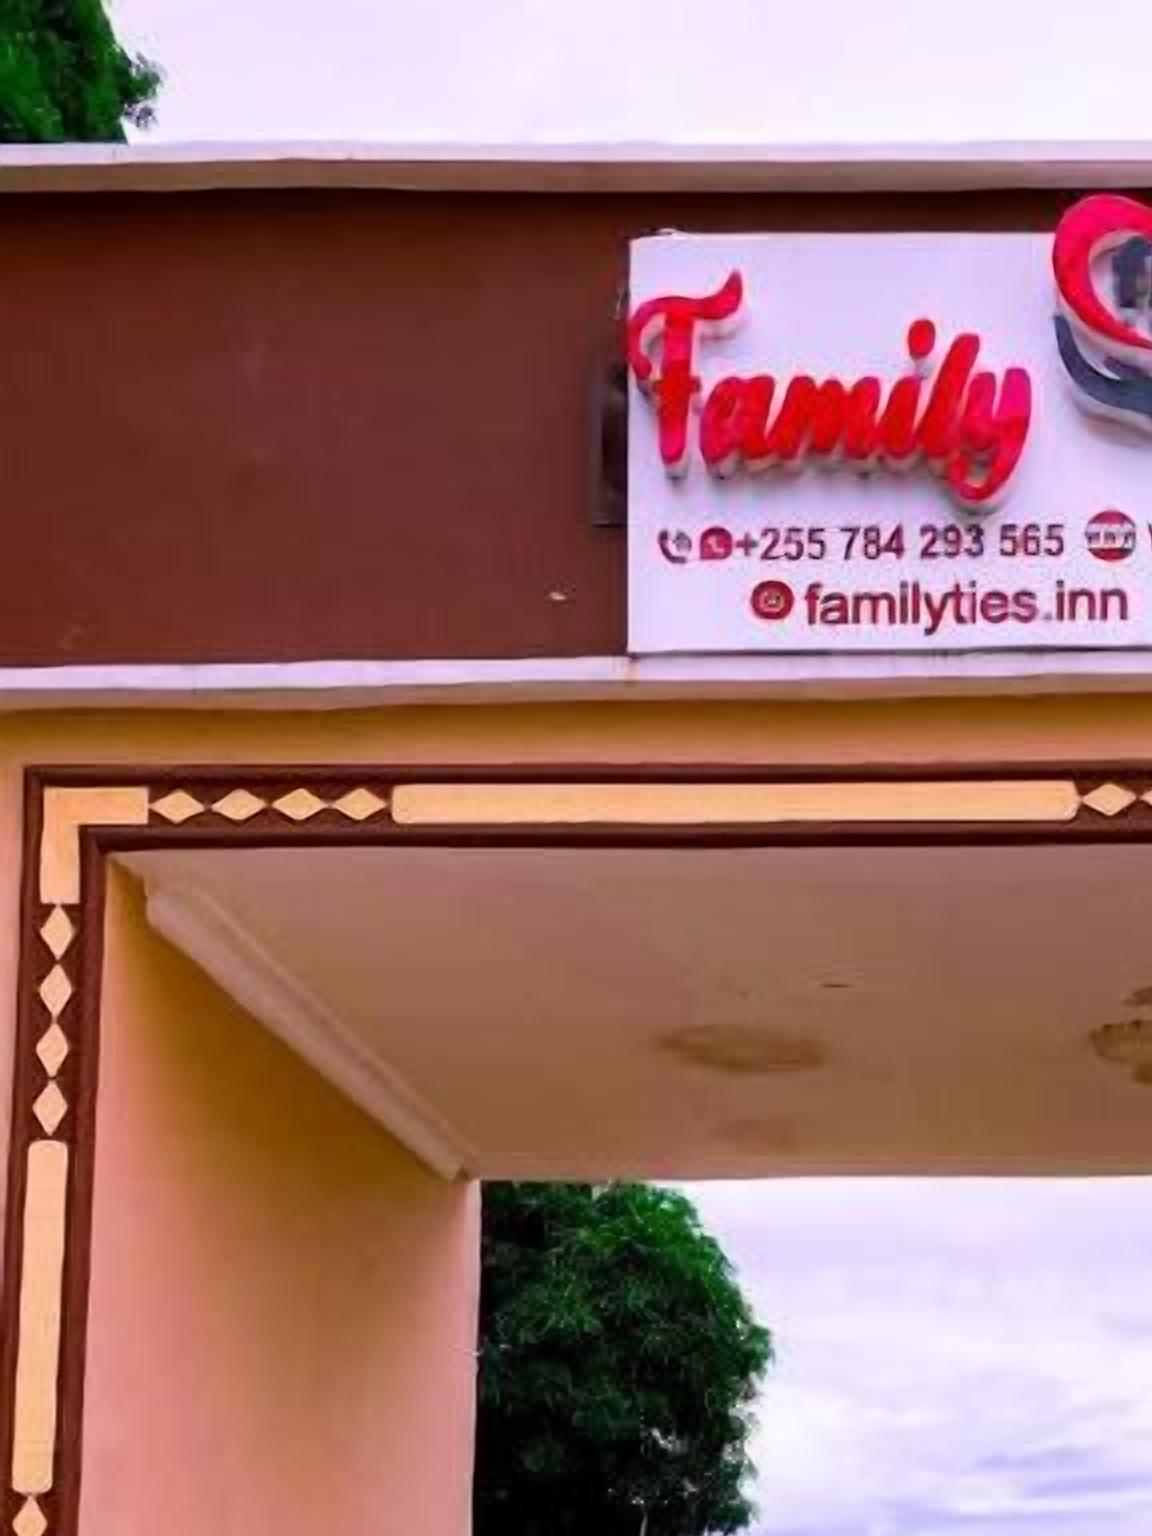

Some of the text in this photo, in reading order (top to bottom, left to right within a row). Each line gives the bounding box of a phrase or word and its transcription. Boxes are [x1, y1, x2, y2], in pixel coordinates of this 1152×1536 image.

[628, 269, 1032, 500] Family
[736, 526, 827, 560] +255
[840, 524, 903, 560] 784
[920, 523, 985, 558] 293
[999, 523, 1065, 557] 565
[804, 580, 1129, 635] familyties.inn
